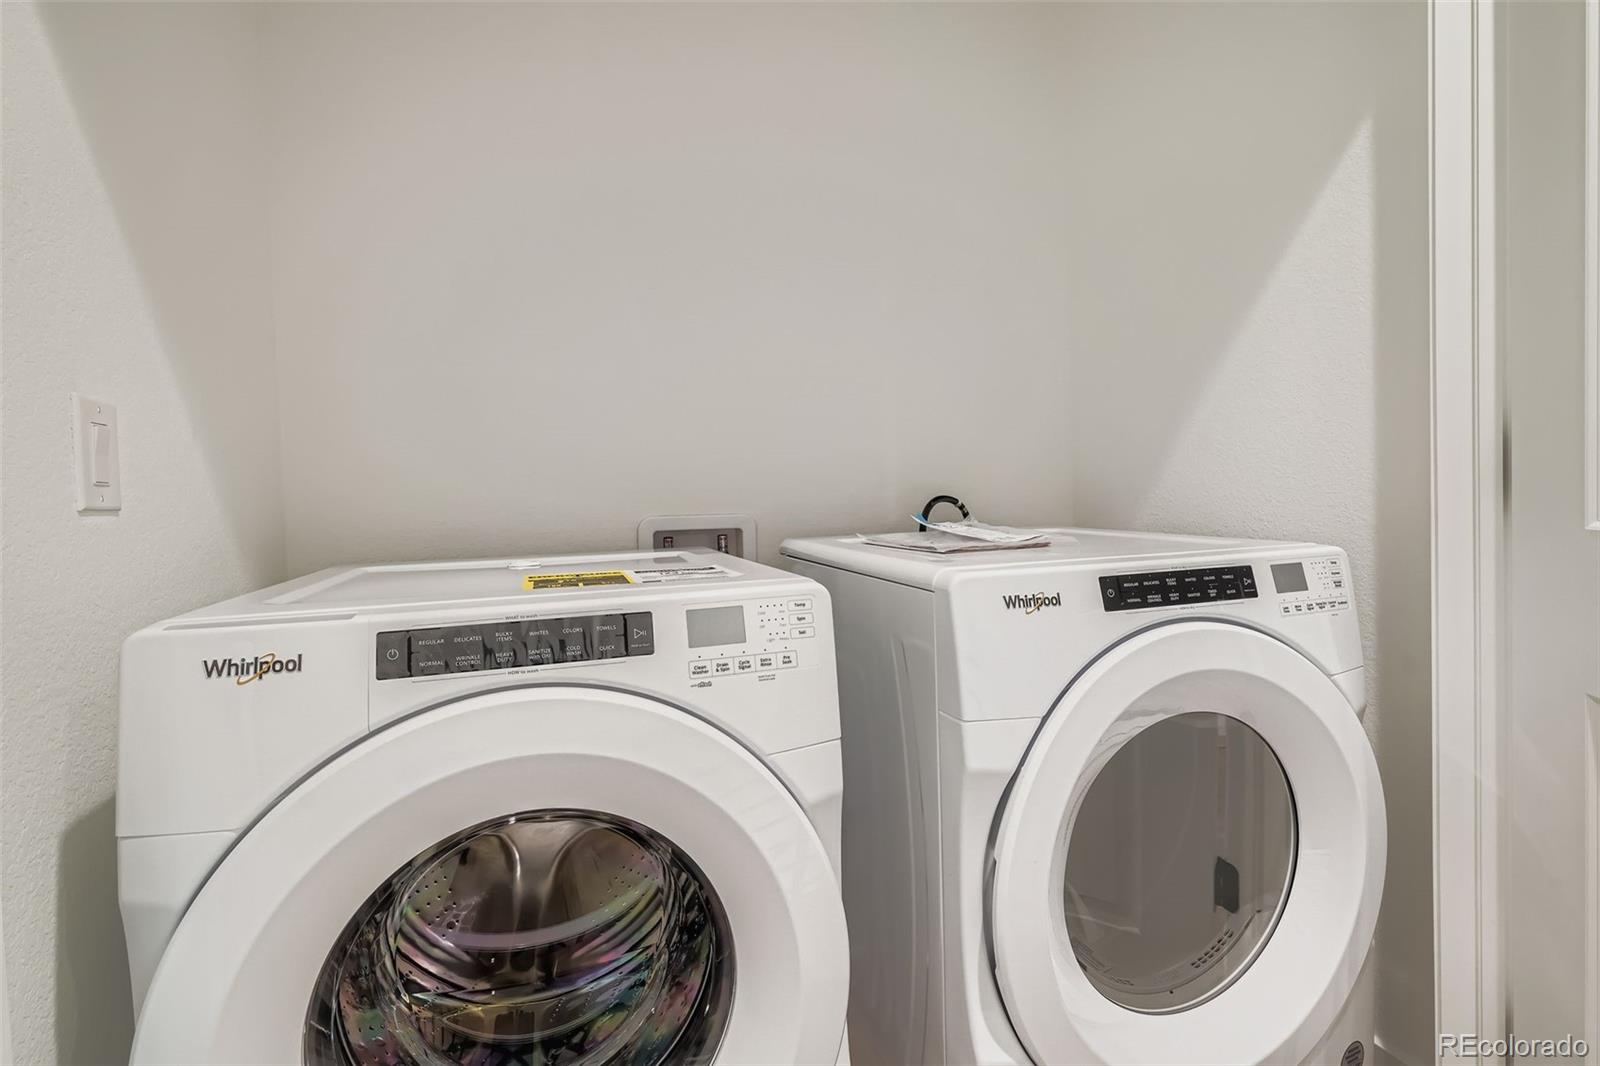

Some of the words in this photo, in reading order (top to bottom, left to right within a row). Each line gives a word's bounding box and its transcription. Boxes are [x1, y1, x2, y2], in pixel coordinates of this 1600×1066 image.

[1002, 592, 1062, 614] Whirlpool
[454, 635, 482, 643] DELICATES
[203, 653, 303, 685] Whirlpool
